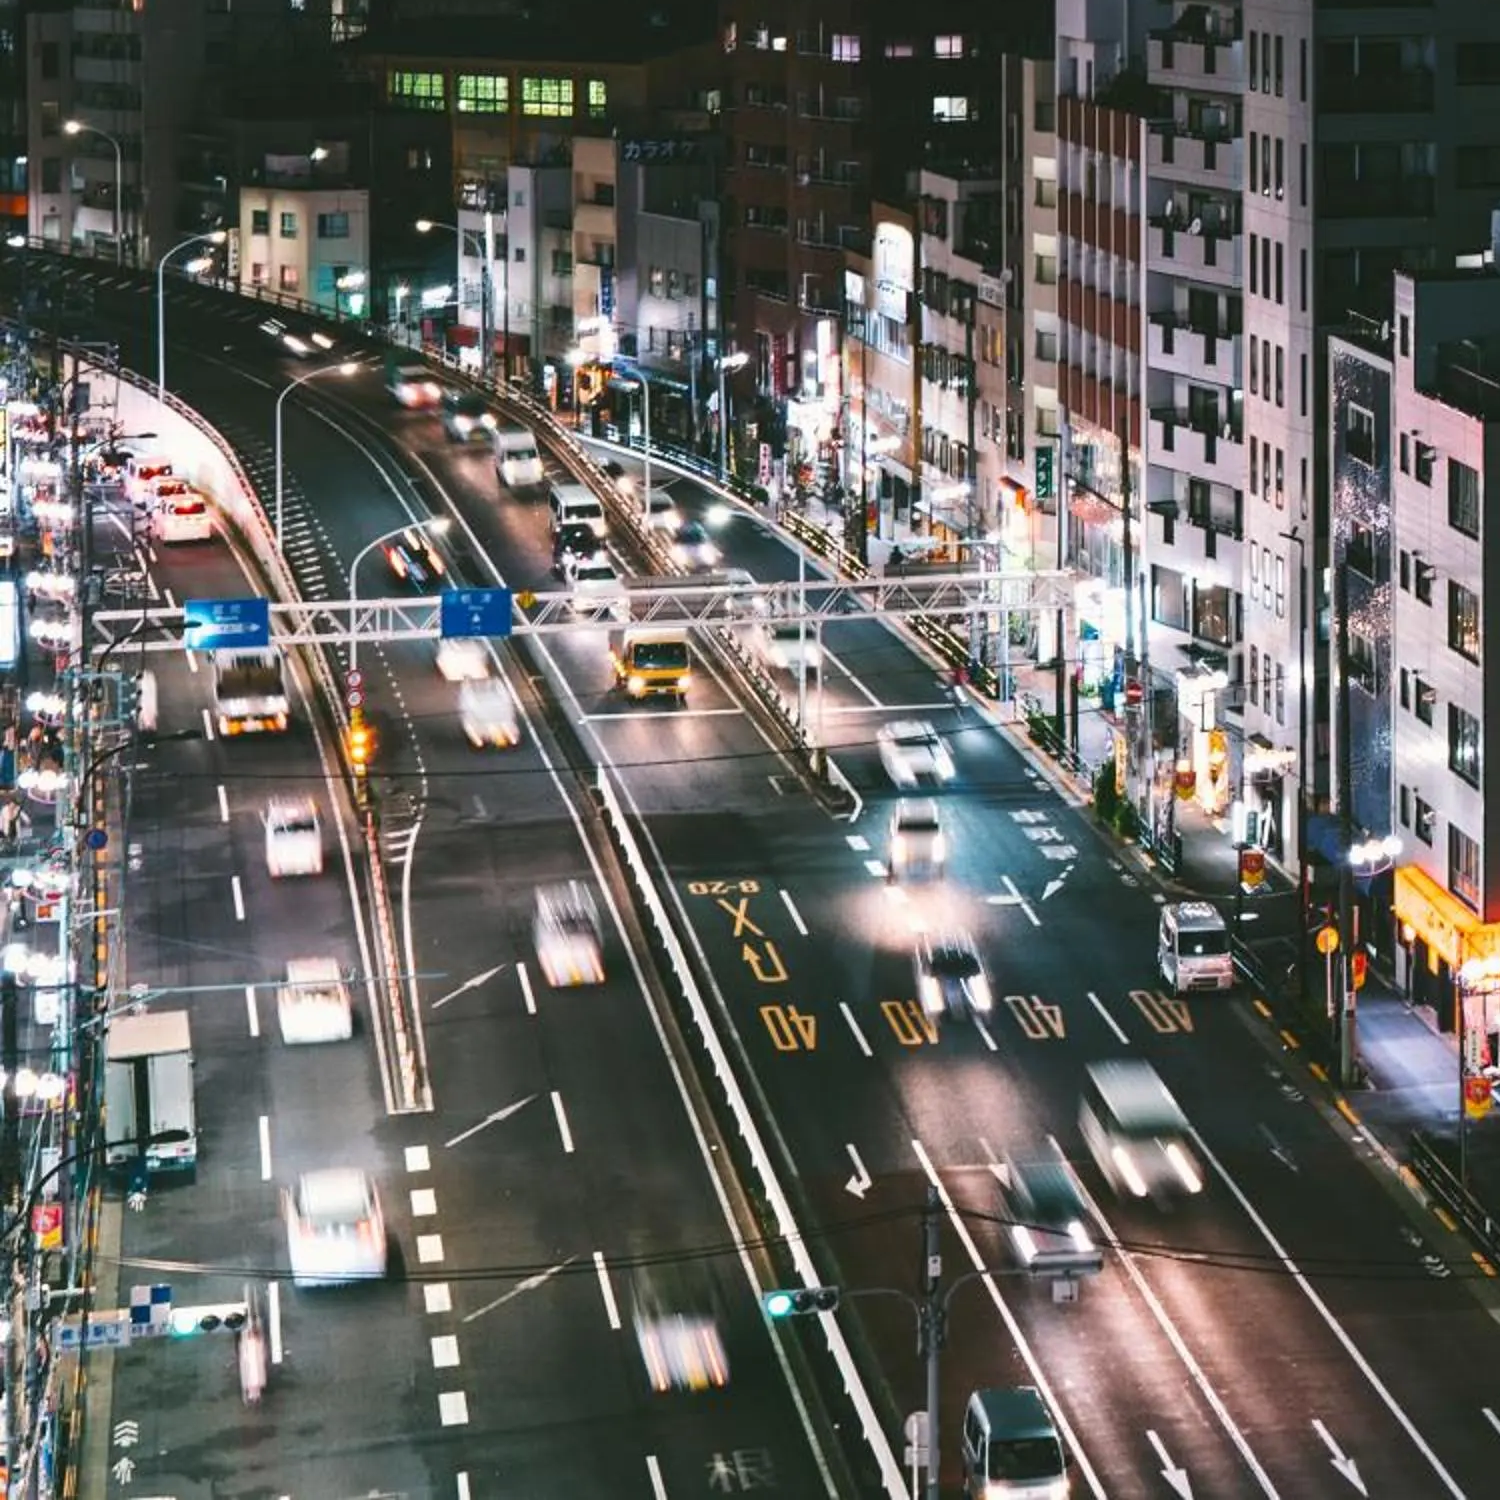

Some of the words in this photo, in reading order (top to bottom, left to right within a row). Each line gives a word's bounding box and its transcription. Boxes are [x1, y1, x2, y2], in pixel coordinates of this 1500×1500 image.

[759, 1004, 816, 1051] 40
[880, 1000, 939, 1045] 40
[1004, 995, 1065, 1039] 40
[1129, 990, 1194, 1033] 40
